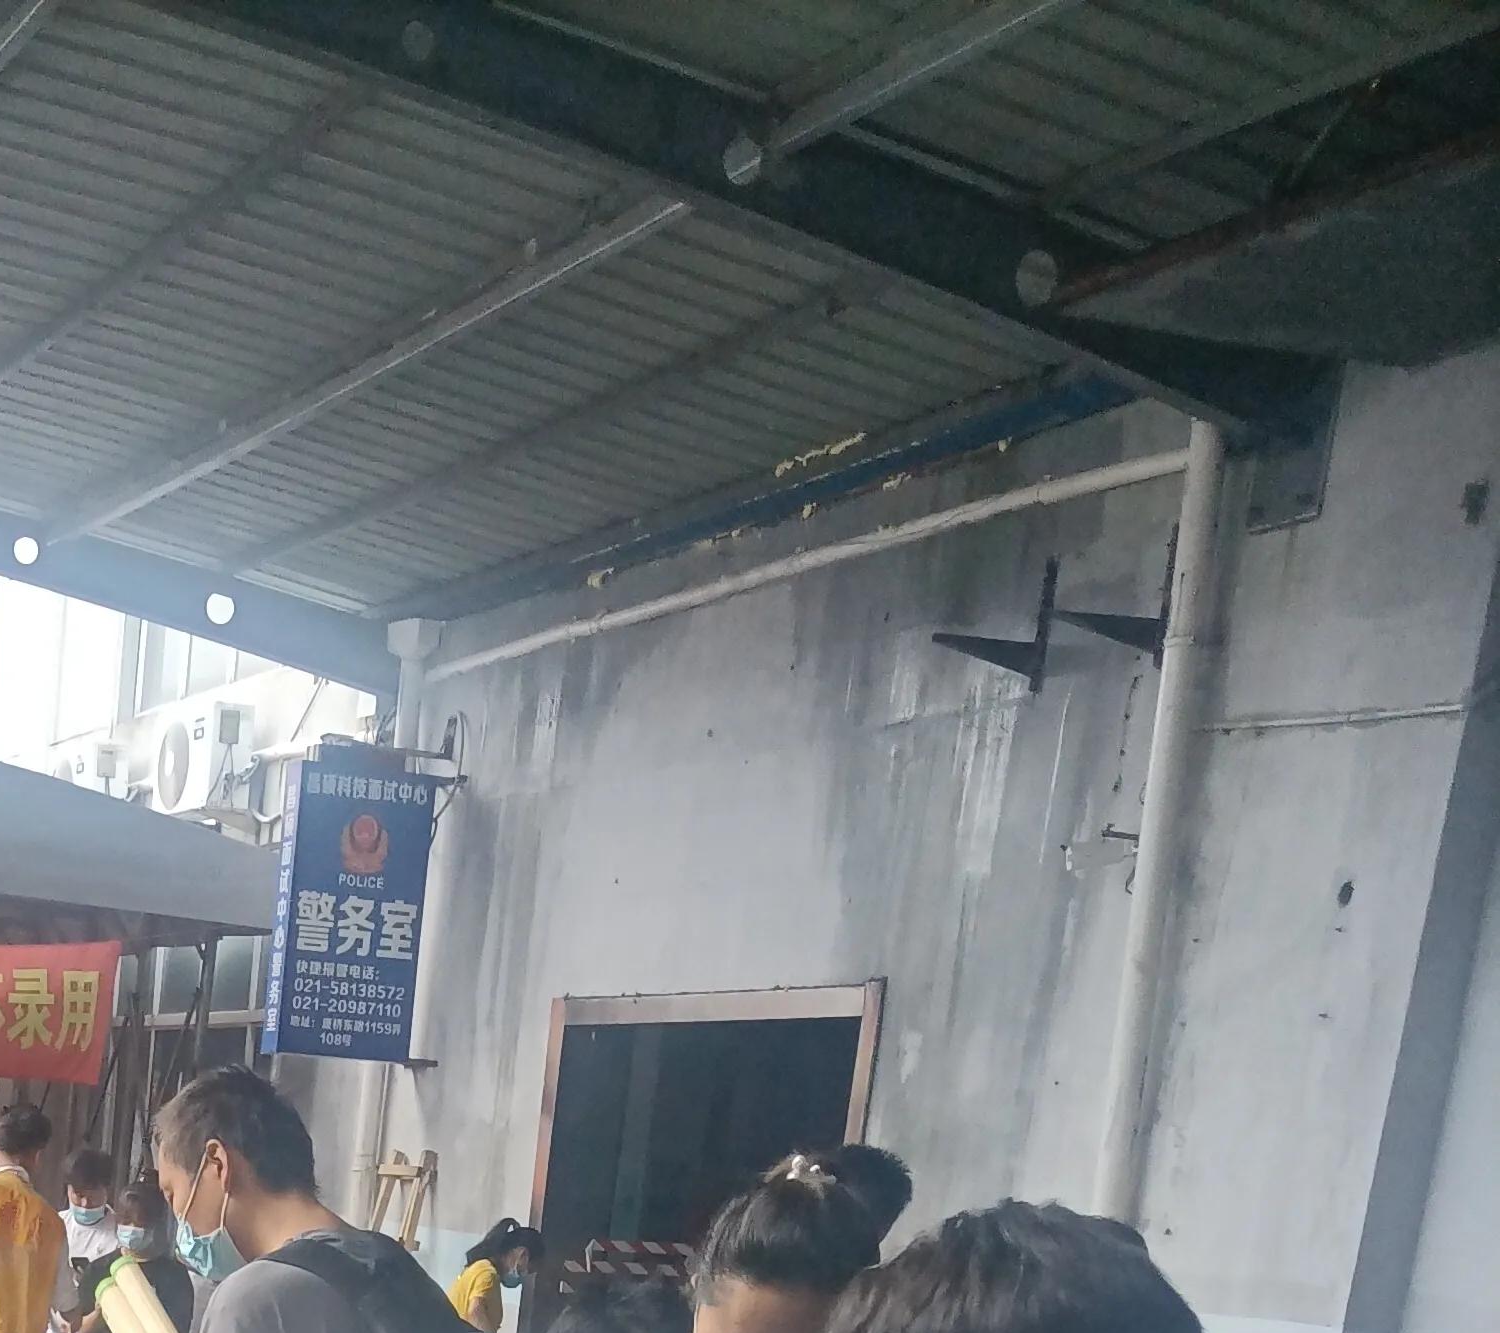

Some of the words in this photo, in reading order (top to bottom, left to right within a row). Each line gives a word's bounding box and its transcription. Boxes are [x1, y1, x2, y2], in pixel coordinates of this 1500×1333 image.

[307, 772, 428, 805] 昌硕科技面试中心
[338, 873, 385, 890] POLICE
[295, 889, 418, 960] 警务室
[294, 978, 405, 1000] 021-58138572
[292, 996, 401, 1017] 021-20987110
[320, 1032, 352, 1047] 108号
